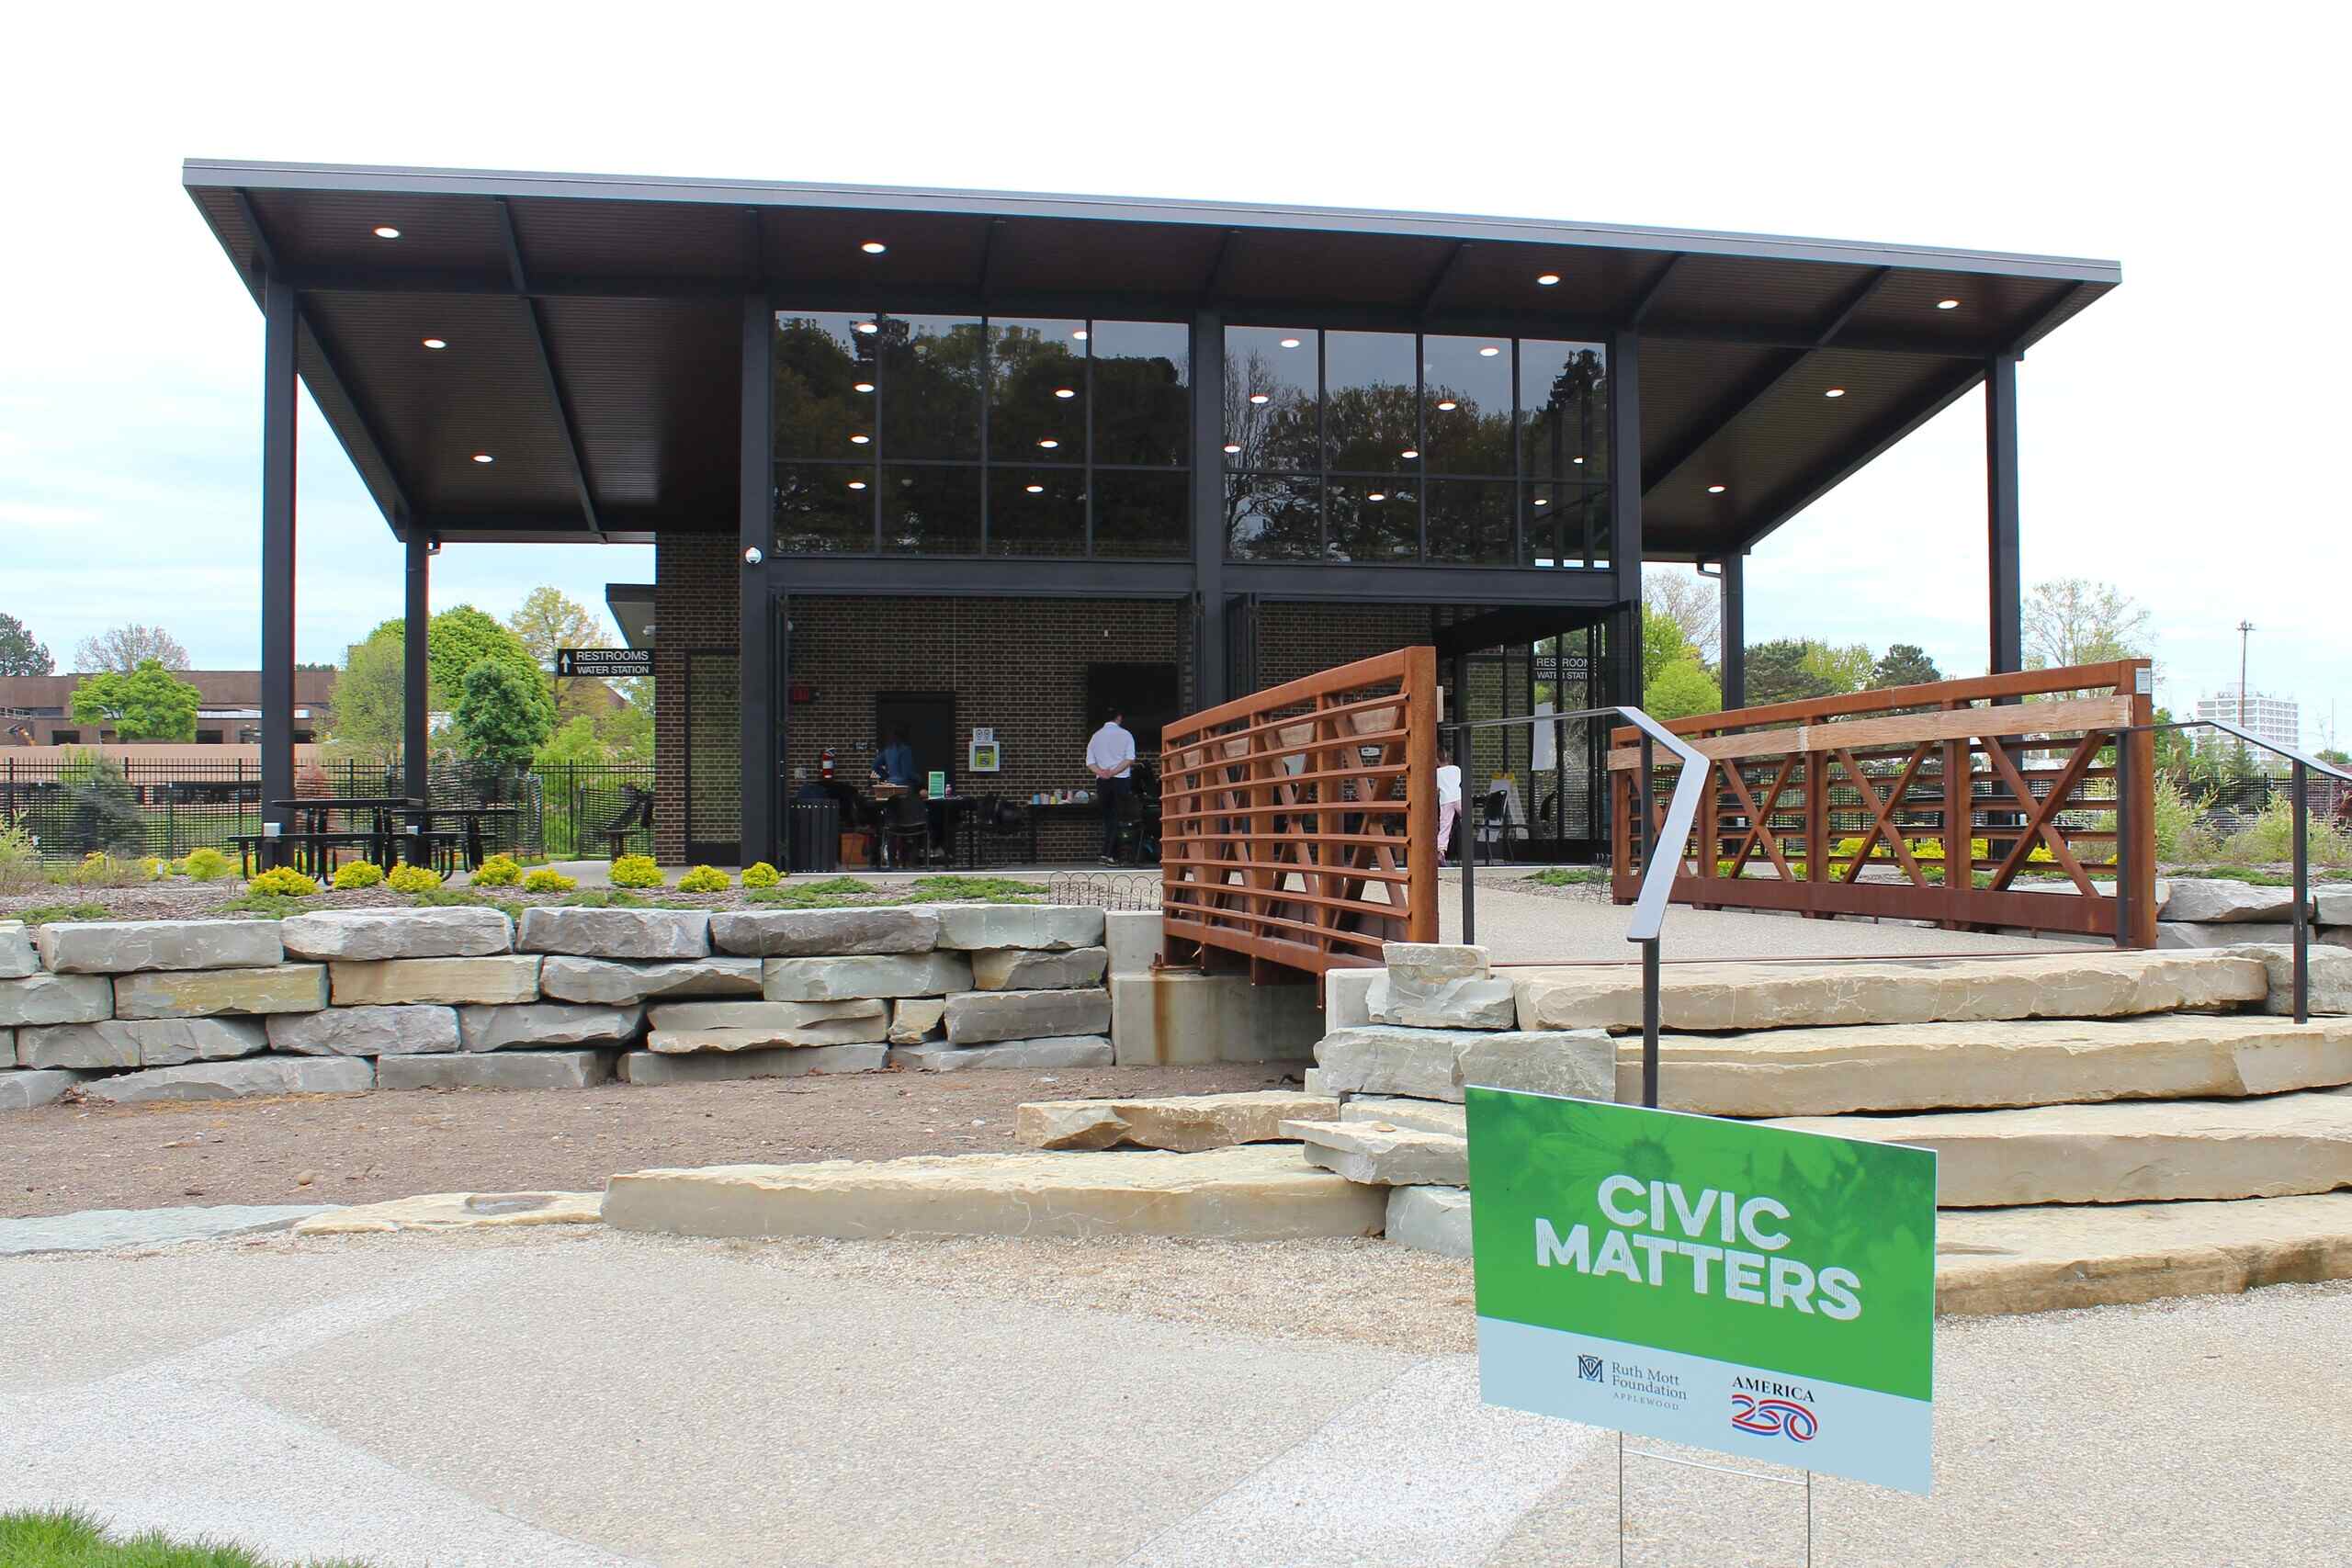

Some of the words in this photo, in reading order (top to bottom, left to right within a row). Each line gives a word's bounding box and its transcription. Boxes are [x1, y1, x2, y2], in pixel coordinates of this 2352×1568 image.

[576, 651, 649, 660] RESTROOMS
[576, 665, 609, 674] WATER
[611, 665, 649, 674] STATION
[1596, 1174, 1792, 1251] CIVIC
[1534, 1217, 1862, 1322] MATTERS
[1611, 1361, 1643, 1379] Ruth
[1647, 1367, 1680, 1386] Mott
[1611, 1373, 1688, 1400] Foundation
[1612, 1391, 1680, 1411] APPLEWOOD
[1732, 1375, 1815, 1404] AMERICA
[1731, 1393, 1818, 1443] 250
